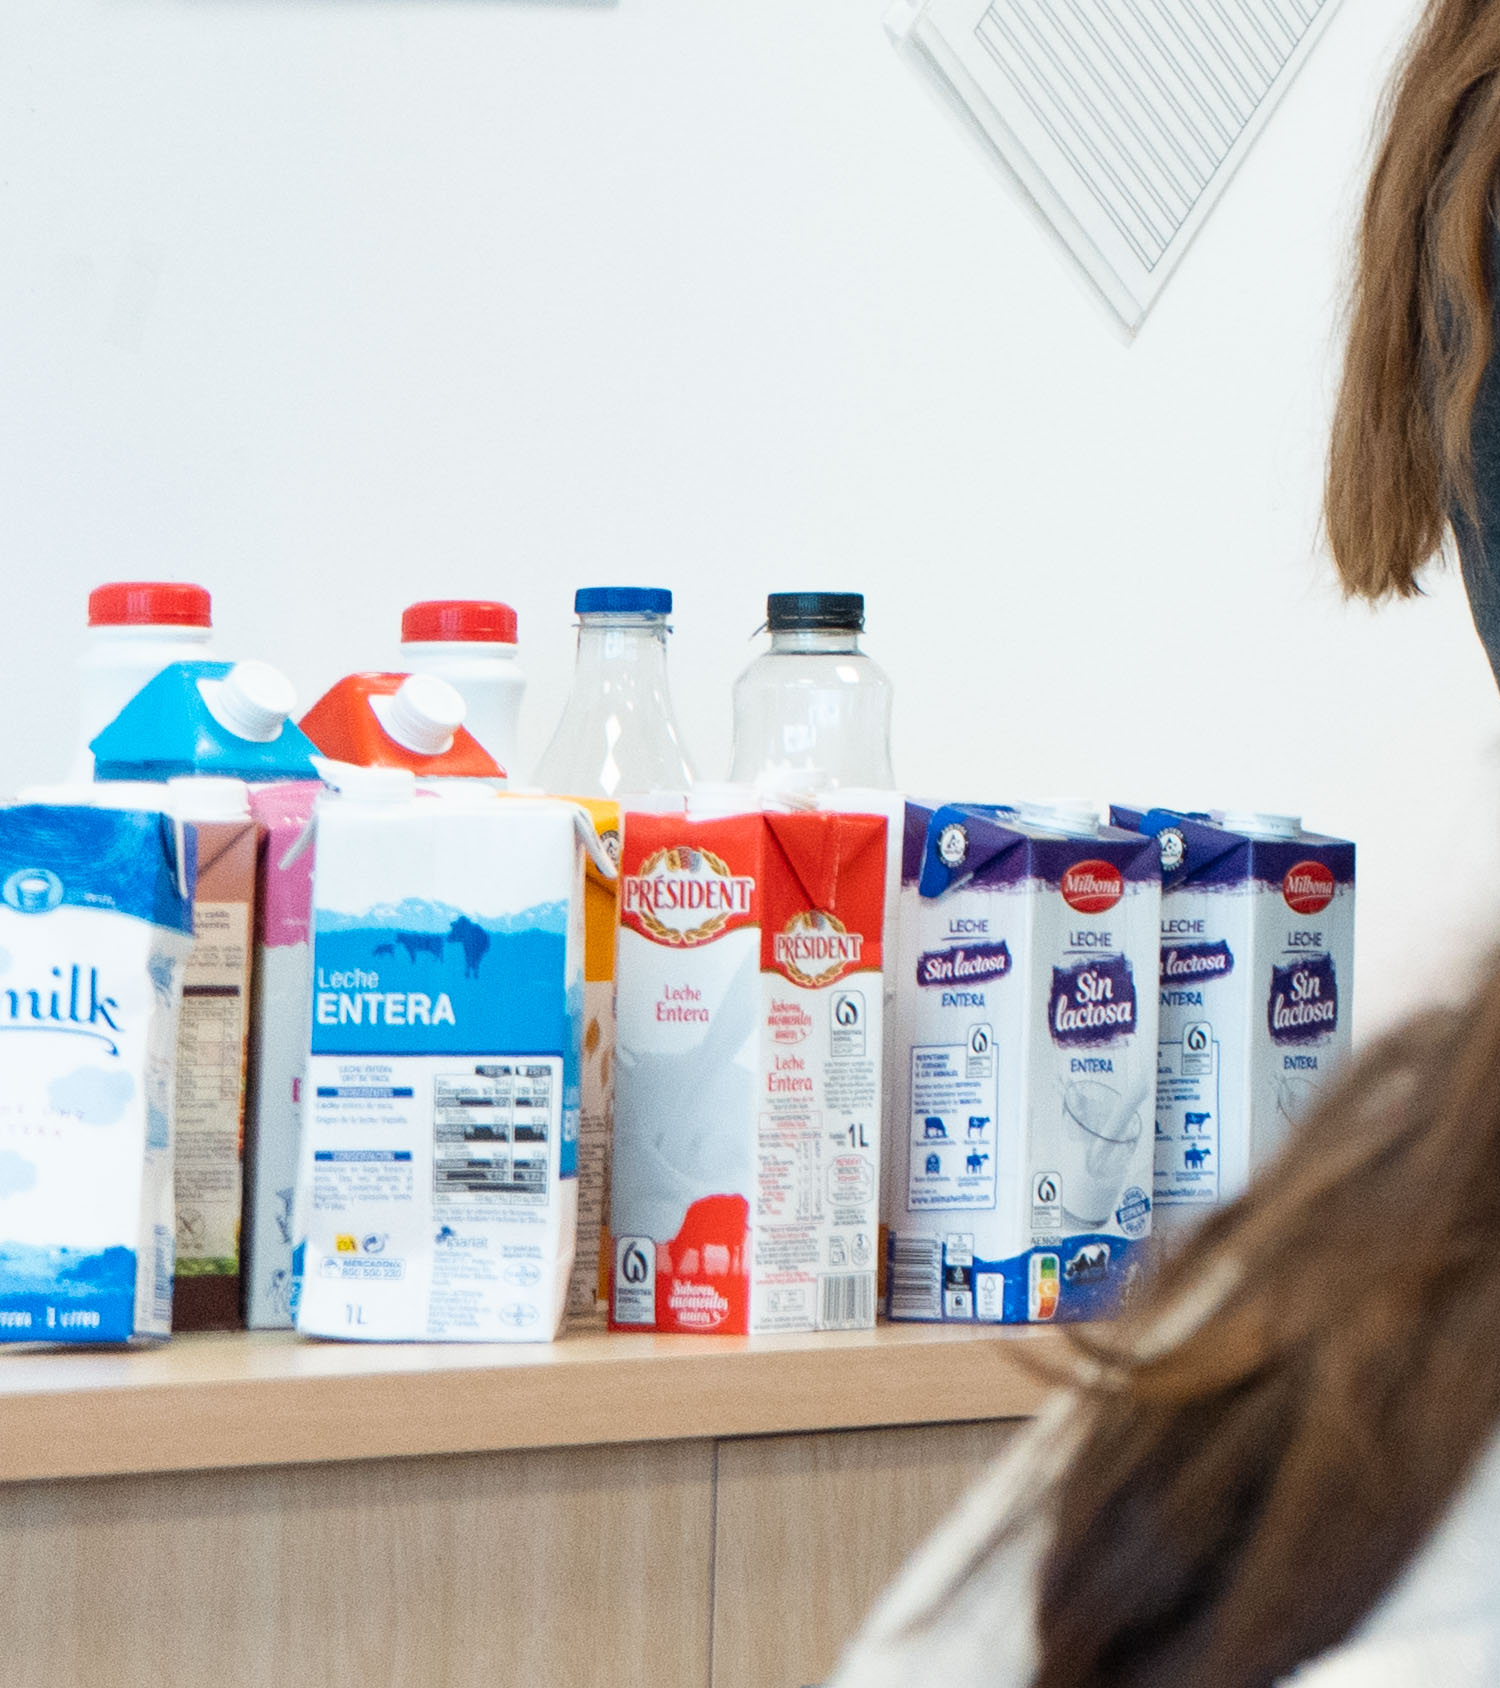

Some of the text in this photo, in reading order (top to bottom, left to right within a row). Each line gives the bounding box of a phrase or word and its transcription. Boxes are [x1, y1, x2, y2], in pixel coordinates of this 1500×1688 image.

[1064, 873, 1121, 895] Milbona
[1285, 875, 1334, 895] Milbona
[625, 875, 751, 915] PRÉSIDENT
[949, 919, 989, 933] LECHE
[1160, 919, 1205, 934] LECHE
[776, 933, 862, 963] PRÉSIDENT
[1069, 931, 1112, 948] LECHE
[1287, 931, 1323, 948] LECHE
[924, 951, 1006, 981] Sin lactosa
[1165, 951, 1226, 978] lactosa
[317, 966, 379, 989] Leche
[1076, 970, 1114, 1004] Sin
[1290, 970, 1321, 1002] Sin
[664, 983, 701, 1001] Leche
[941, 992, 986, 1008] ENTERA
[1160, 991, 1204, 1007] NTERA
[316, 992, 457, 1026] ENTERA
[655, 1002, 710, 1023] Entera
[1055, 994, 1133, 1033] lactosa
[1273, 993, 1335, 1031] lactosa
[774, 1054, 805, 1071] Leche
[1070, 1058, 1114, 1073] ENTERA
[1283, 1055, 1319, 1071] ENTERA
[767, 1072, 814, 1093] Entera
[847, 1123, 870, 1149] 1L
